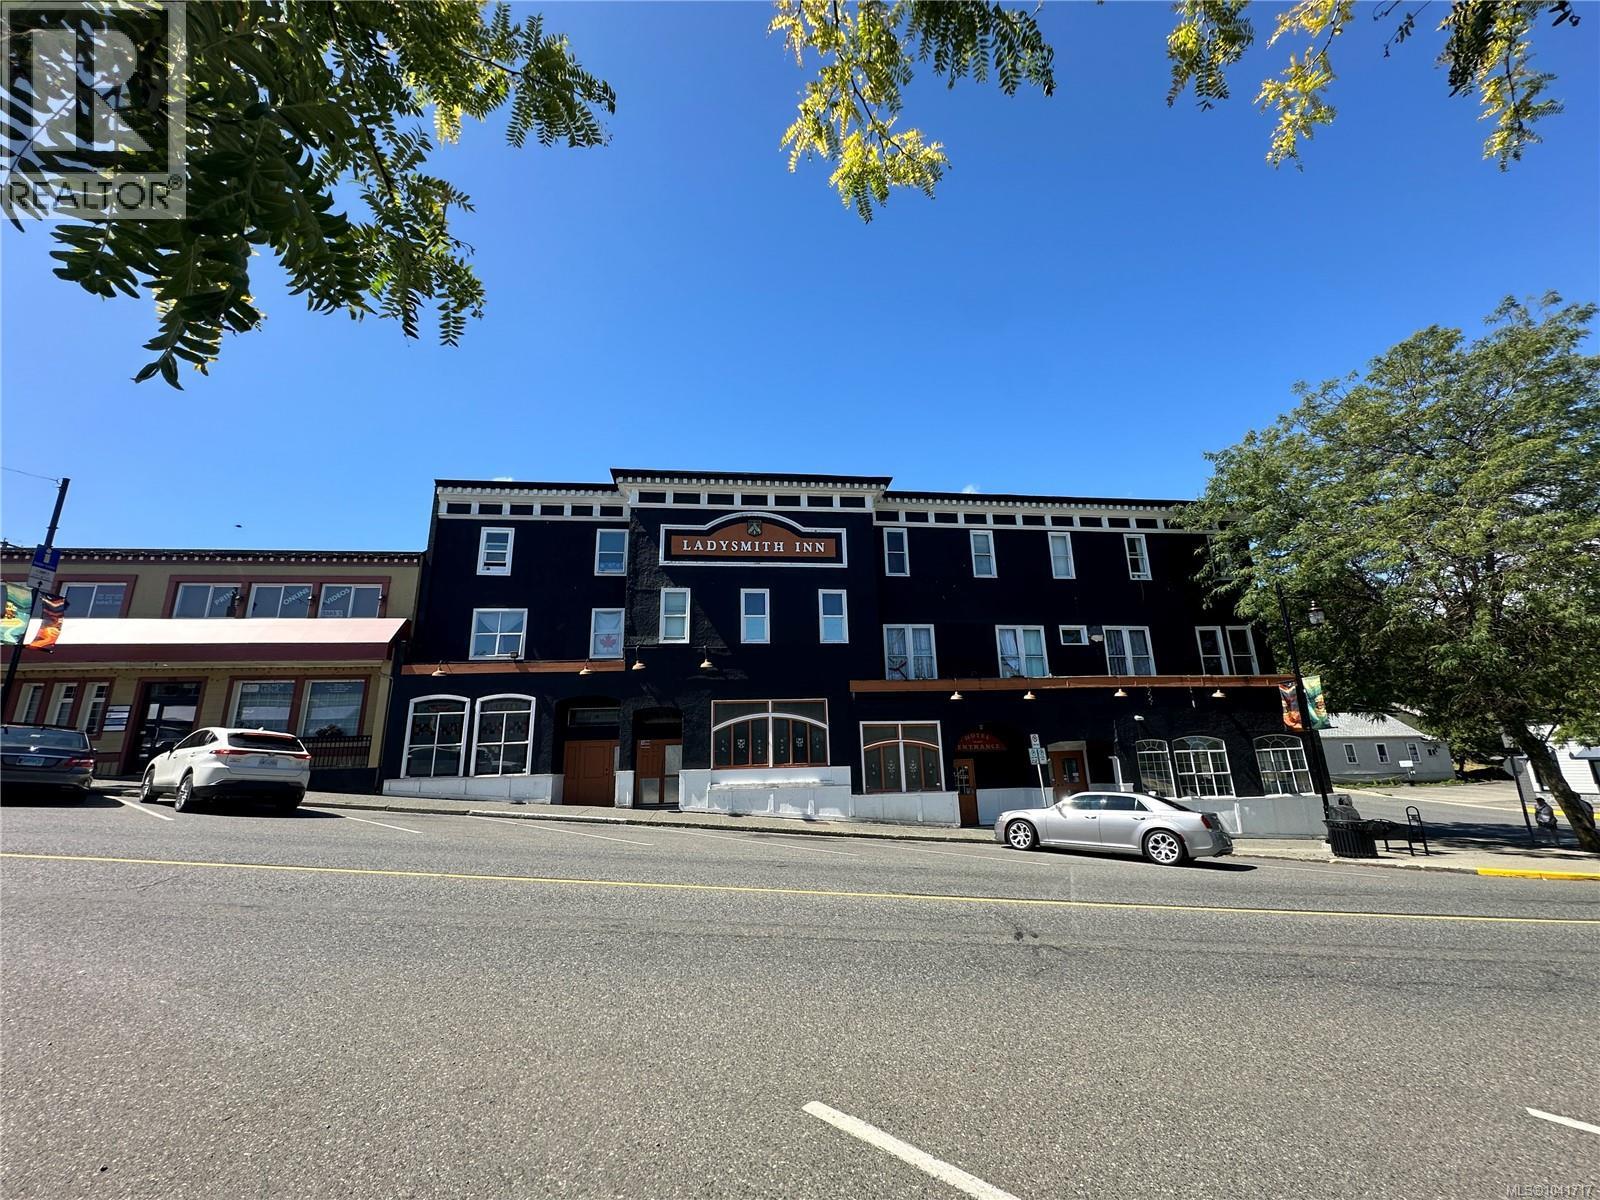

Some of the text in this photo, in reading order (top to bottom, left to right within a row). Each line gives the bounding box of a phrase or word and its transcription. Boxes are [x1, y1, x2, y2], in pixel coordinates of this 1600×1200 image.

[682, 539, 826, 553] LADYSMITH INN
[214, 588, 237, 606] PRINT
[283, 588, 310, 606] ONLINE
[324, 588, 350, 605] VIDEOS
[964, 732, 990, 741] HOTEL
[957, 743, 1001, 751] ENTRANCE
